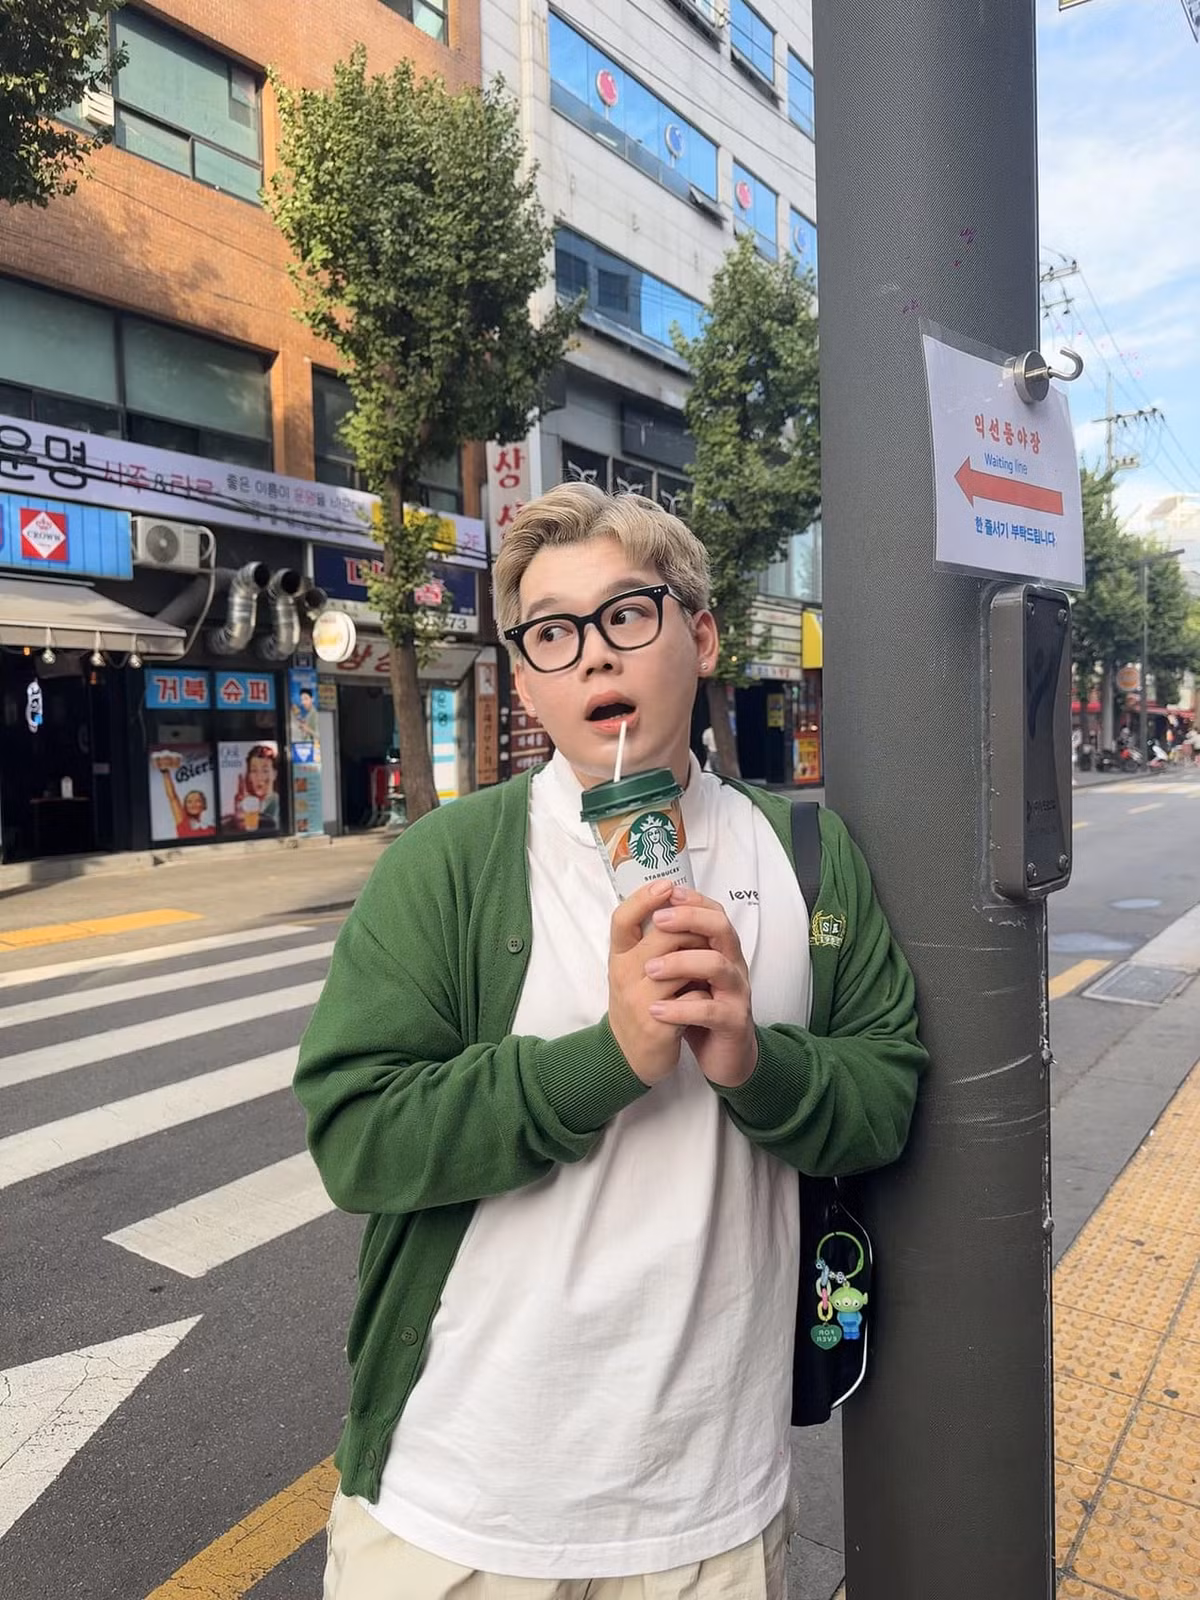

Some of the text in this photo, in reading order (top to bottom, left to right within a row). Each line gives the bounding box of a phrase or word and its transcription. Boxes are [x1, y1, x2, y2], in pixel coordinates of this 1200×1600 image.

[974, 413, 1041, 454] 익선동야장
[984, 453, 1028, 475] Waiting line
[254, 479, 291, 500] 이름이
[975, 515, 1056, 547] 한 줄서기 부탁드립니다
[155, 677, 207, 703] 거북
[222, 678, 270, 704] 슈퍼
[644, 867, 681, 882] STARBUCKS
